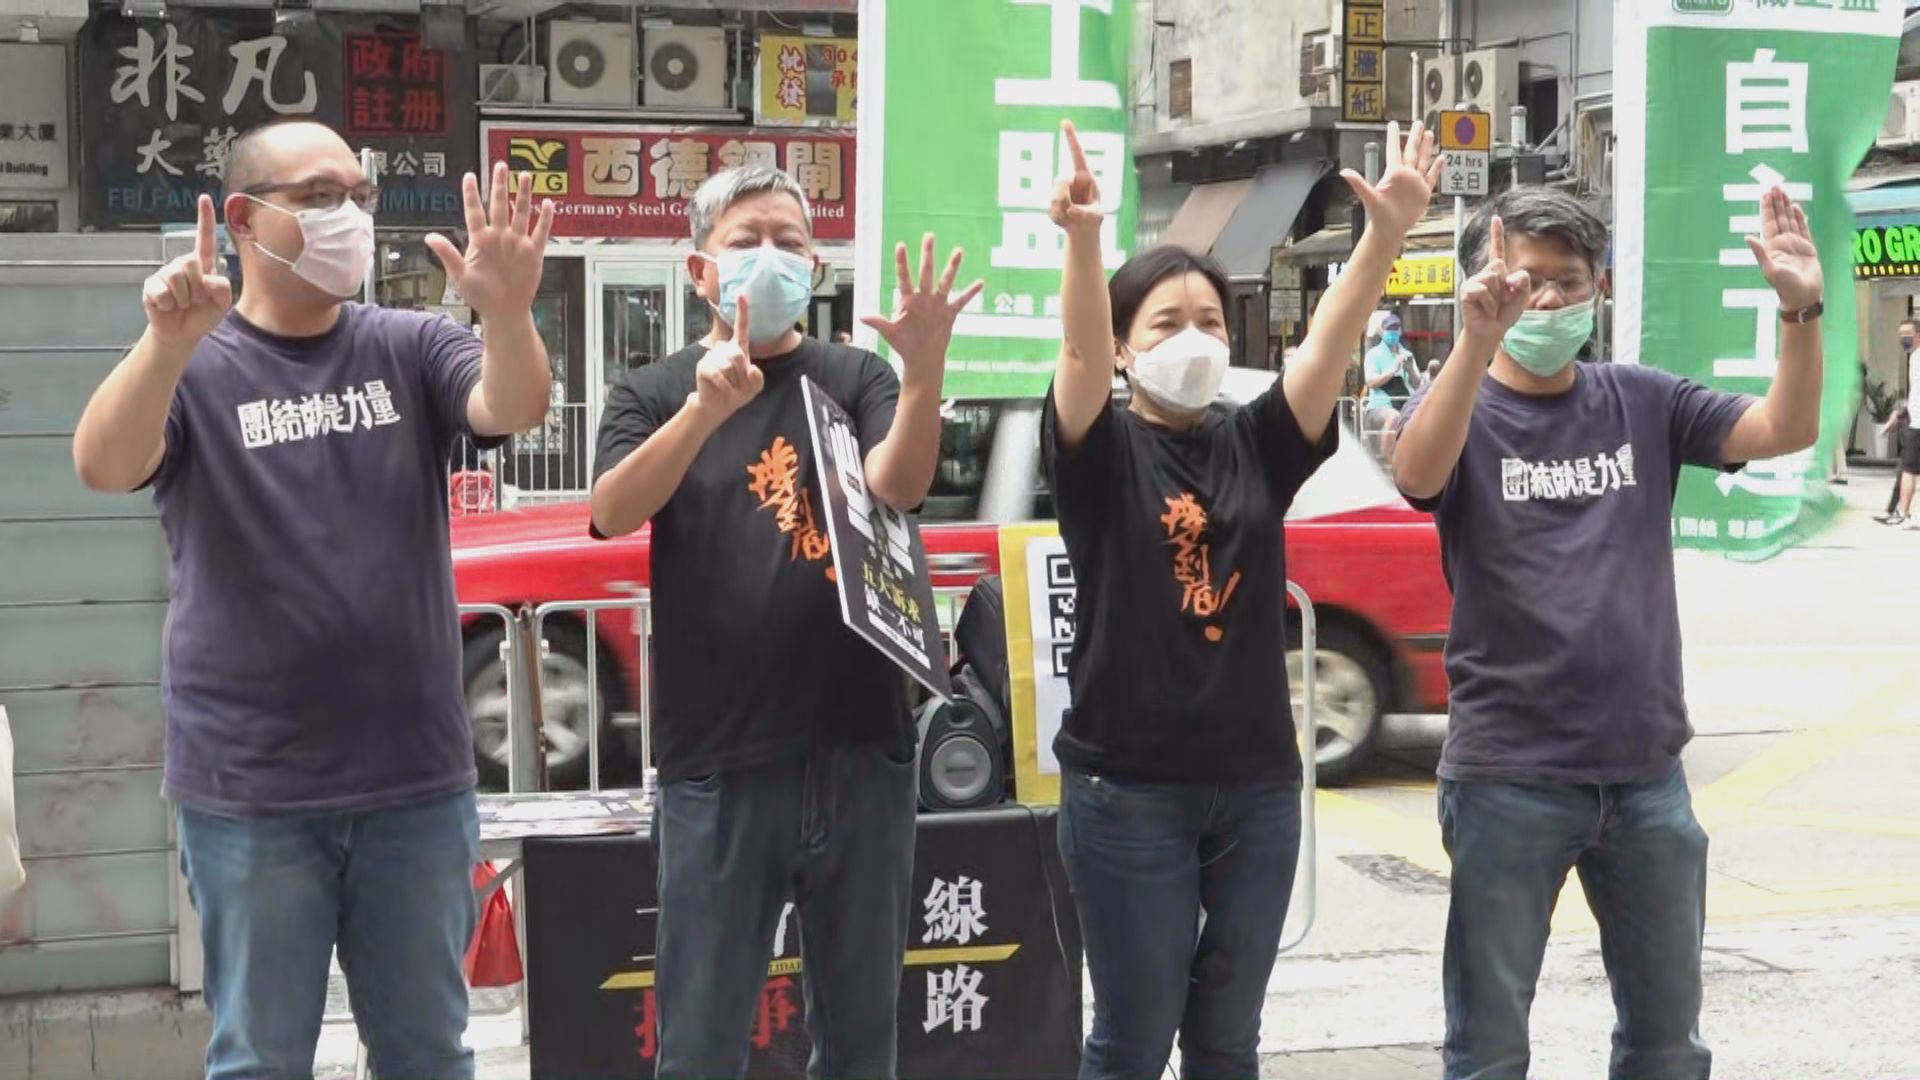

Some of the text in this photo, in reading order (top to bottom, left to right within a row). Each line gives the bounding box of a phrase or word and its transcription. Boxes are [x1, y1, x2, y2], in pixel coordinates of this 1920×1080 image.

[109, 23, 318, 121] 非凡
[351, 40, 440, 80] 政府
[1446, 154, 1483, 168] 24 hrs
[1450, 171, 1480, 190] 全日
[382, 190, 459, 214] IMITED
[553, 201, 624, 218] Germany
[628, 202, 666, 216] Steel
[237, 378, 401, 449] 團結就是力量
[1501, 442, 1637, 502] 團結就是力量
